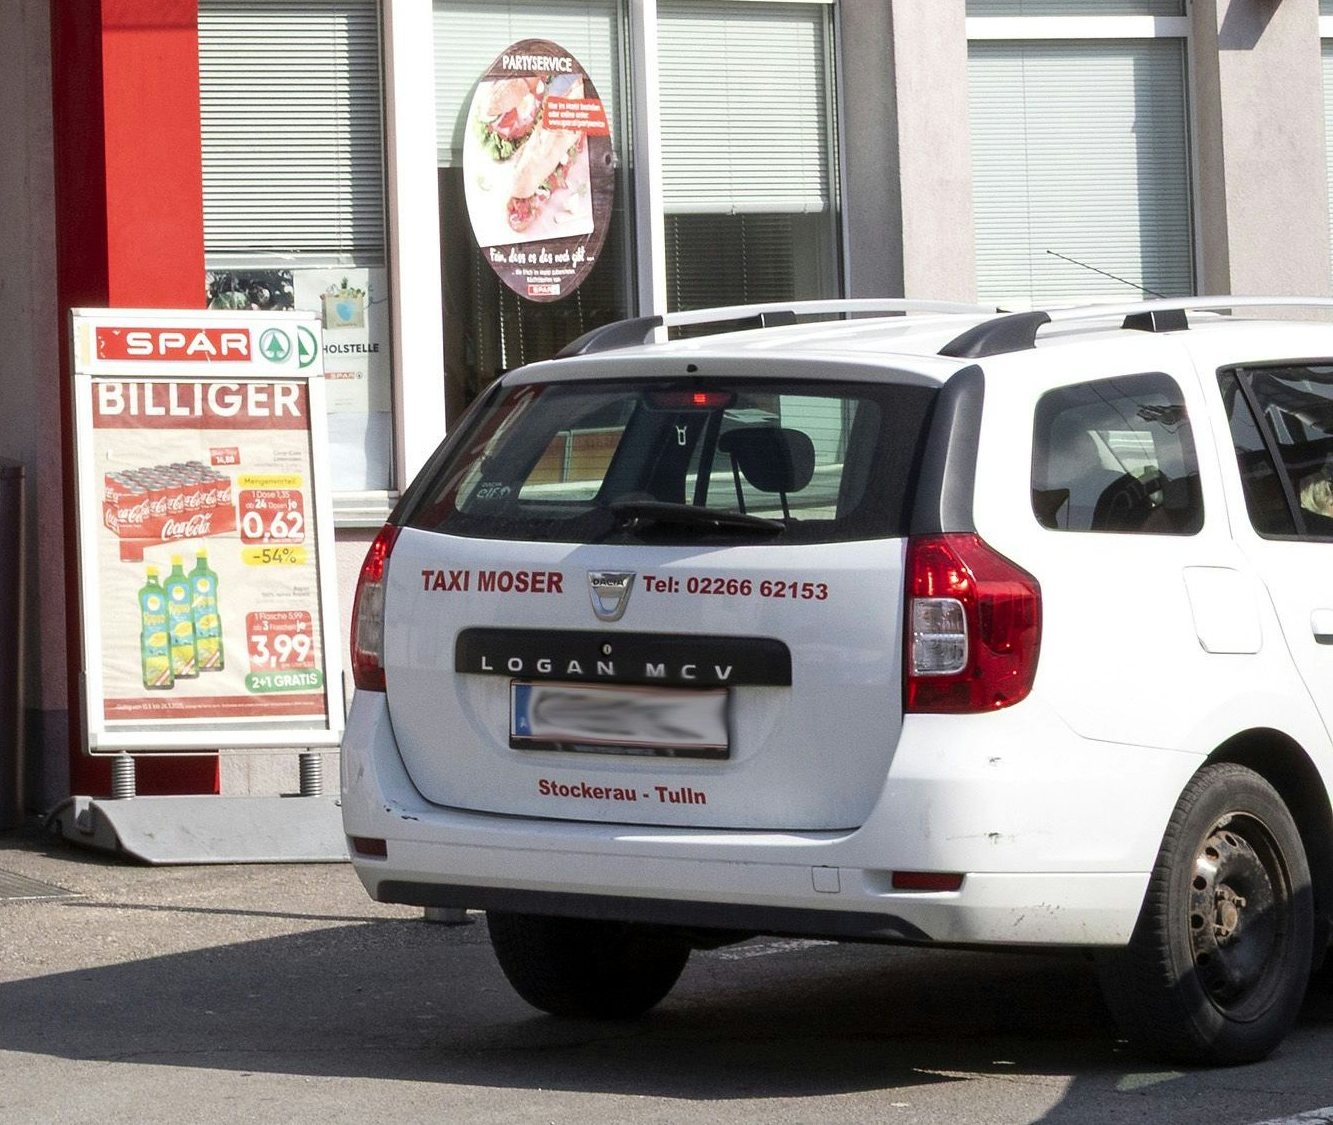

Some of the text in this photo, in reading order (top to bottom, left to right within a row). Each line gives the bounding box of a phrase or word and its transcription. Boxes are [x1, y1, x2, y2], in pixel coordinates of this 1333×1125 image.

[502, 55, 573, 72] PARTYSERVICE
[528, 253, 537, 264] es
[554, 249, 570, 263] noch
[571, 246, 585, 268] gibt
[126, 332, 248, 356] SPAR
[323, 343, 380, 354] HOLSTELLE
[98, 383, 302, 417] BILLIGER
[244, 478, 297, 486] Mengenvorteil
[256, 491, 276, 499] Dose
[255, 499, 267, 509] 24
[268, 501, 288, 509] Dosen
[288, 499, 298, 511] je
[243, 510, 305, 542] 0,62
[252, 548, 297, 564] -54%
[421, 570, 564, 594] TAXI MOSER
[592, 578, 624, 587] DACIA
[643, 575, 829, 601] Tel: 02266 62153
[259, 612, 288, 620] Flasche
[262, 621, 269, 630] 3
[296, 619, 306, 632] je
[251, 634, 311, 668] 3,99
[481, 656, 733, 680] LOGAN MCV
[251, 674, 318, 689] 2+1 GRATIS
[538, 779, 637, 802] Stockerau
[655, 786, 707, 805] Tulln
